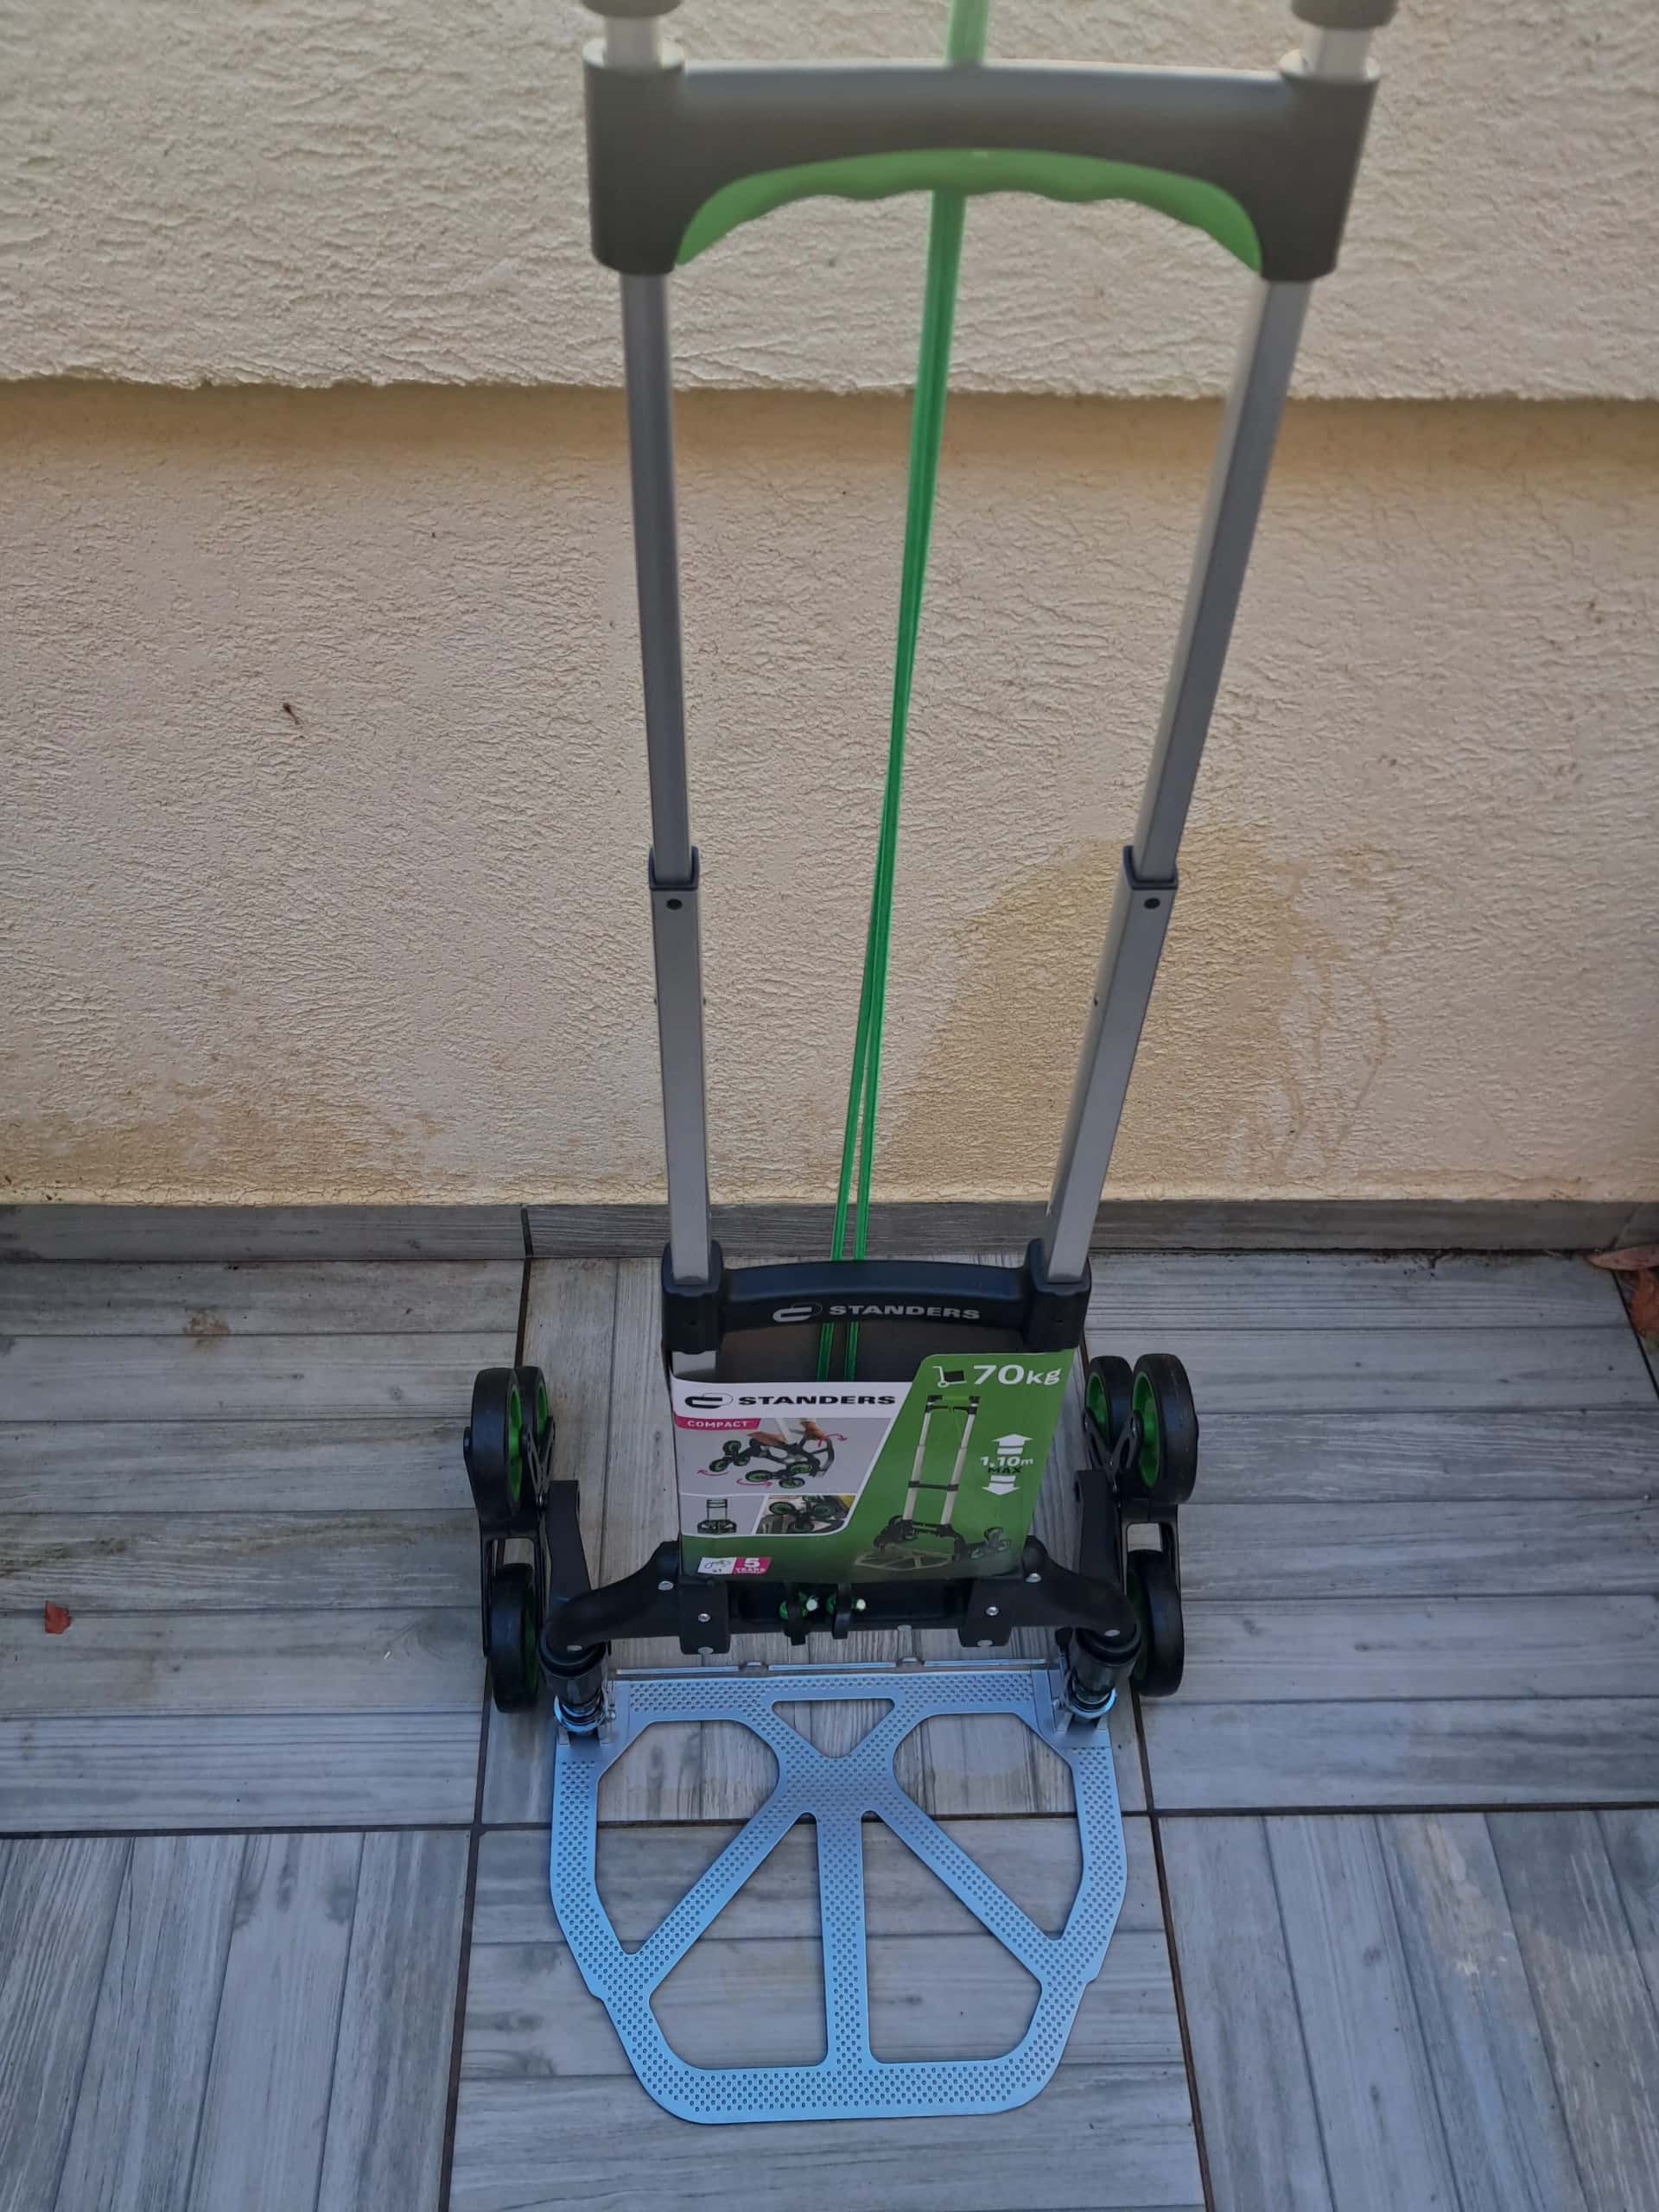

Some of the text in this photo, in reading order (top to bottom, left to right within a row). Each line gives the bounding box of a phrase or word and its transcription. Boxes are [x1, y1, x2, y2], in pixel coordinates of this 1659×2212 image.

[829, 1305, 981, 1319] STANDERS
[973, 1363, 1062, 1386] 70kg
[738, 1395, 896, 1405] STANDERS
[687, 1420, 748, 1428] COMPACT
[744, 1557, 760, 1568] 5
